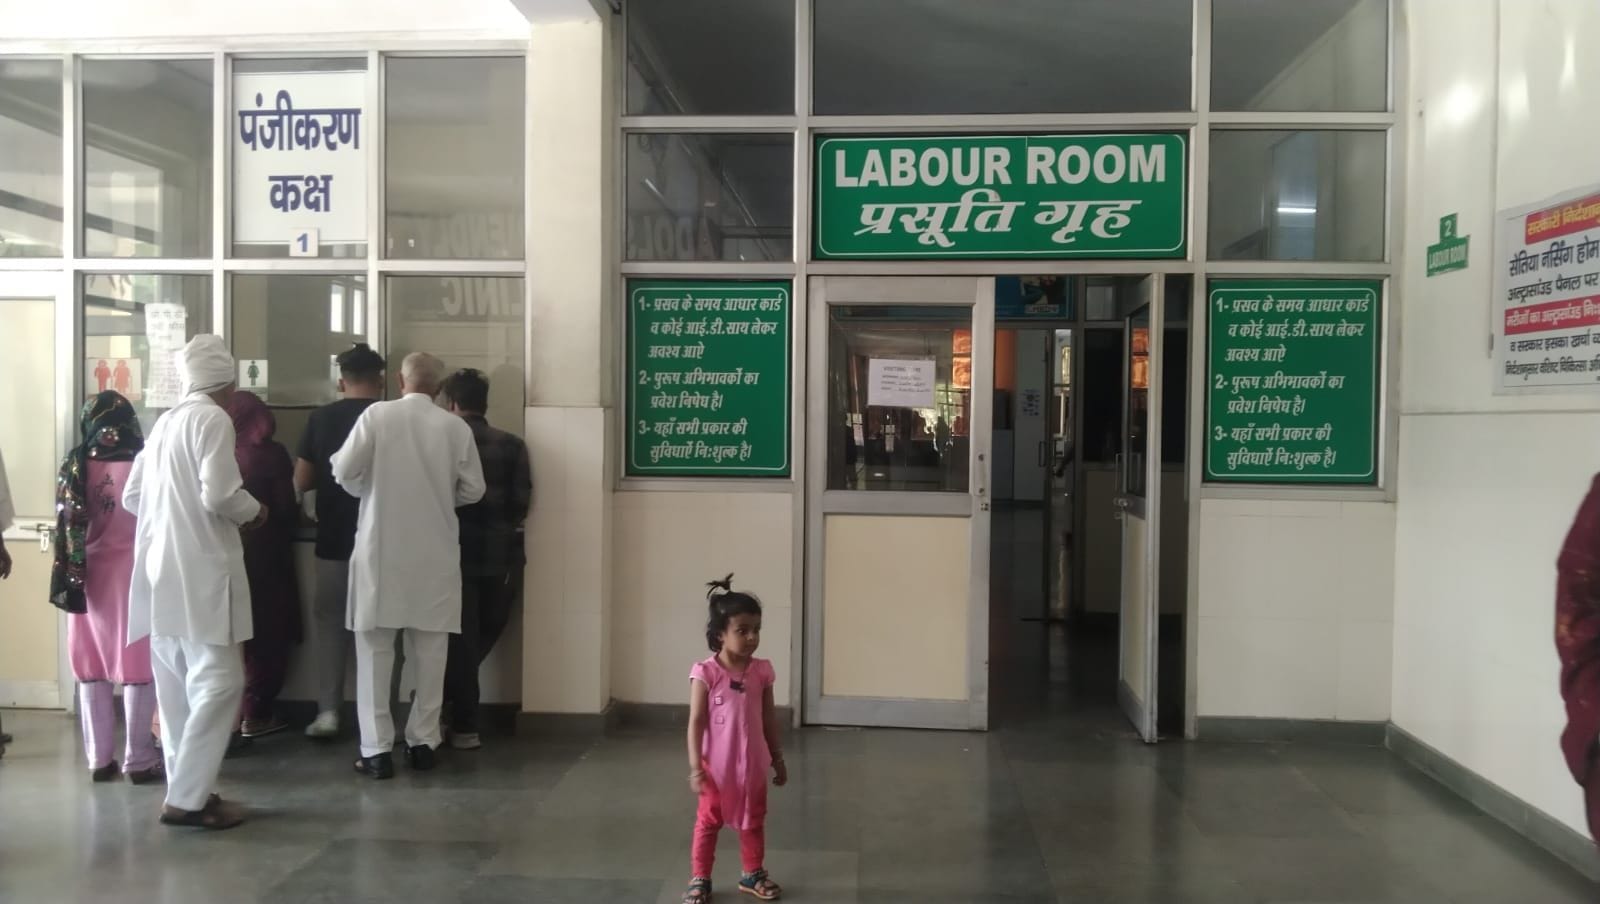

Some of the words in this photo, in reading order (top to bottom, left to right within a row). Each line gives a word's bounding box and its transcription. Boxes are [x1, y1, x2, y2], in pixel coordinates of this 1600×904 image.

[238, 90, 362, 151] पंजीकरण
[835, 145, 1012, 188] LABOUR
[1026, 144, 1166, 186] ROOM
[268, 175, 333, 213] कक्ष
[854, 188, 1025, 248] प्रसूति
[1034, 199, 1142, 244] गृह
[1444, 220, 1453, 237] 2
[296, 232, 308, 252] 1
[1577, 235, 1600, 264] होम
[1555, 274, 1582, 292] पैनल
[1583, 271, 1600, 287] पर
[653, 298, 680, 312] प्रसव
[681, 293, 693, 312] के
[694, 298, 721, 312] समय
[723, 298, 758, 312] आधार
[759, 293, 782, 312] कार्ड
[1232, 299, 1260, 313] प्रसव
[1262, 295, 1274, 313] के
[1275, 299, 1304, 313] समय
[1306, 299, 1342, 313] आधार
[1345, 294, 1370, 313] कार्ड
[651, 321, 660, 336] व
[661, 317, 683, 337] कोई
[751, 318, 779, 336] लेकर
[1228, 323, 1239, 337] व
[1240, 319, 1264, 339] कोई
[1335, 319, 1366, 337] लेकर
[648, 344, 681, 359] अवश्य
[1225, 347, 1260, 362] अवश्य
[682, 367, 743, 385] अभिभावकों
[744, 372, 760, 385] का
[1262, 371, 1327, 389] अभिभावकों
[1328, 375, 1345, 389] का
[650, 391, 677, 409] प्रवेश
[1227, 396, 1257, 414] प्रवेश
[653, 417, 675, 437] यहाँ
[676, 417, 700, 435] सभी
[701, 421, 731, 435] प्रकार
[732, 417, 748, 435] की
[1231, 422, 1255, 443] यहाँ
[1255, 422, 1281, 441] सभी
[1282, 427, 1313, 441] प्रकार
[1314, 422, 1332, 441] की
